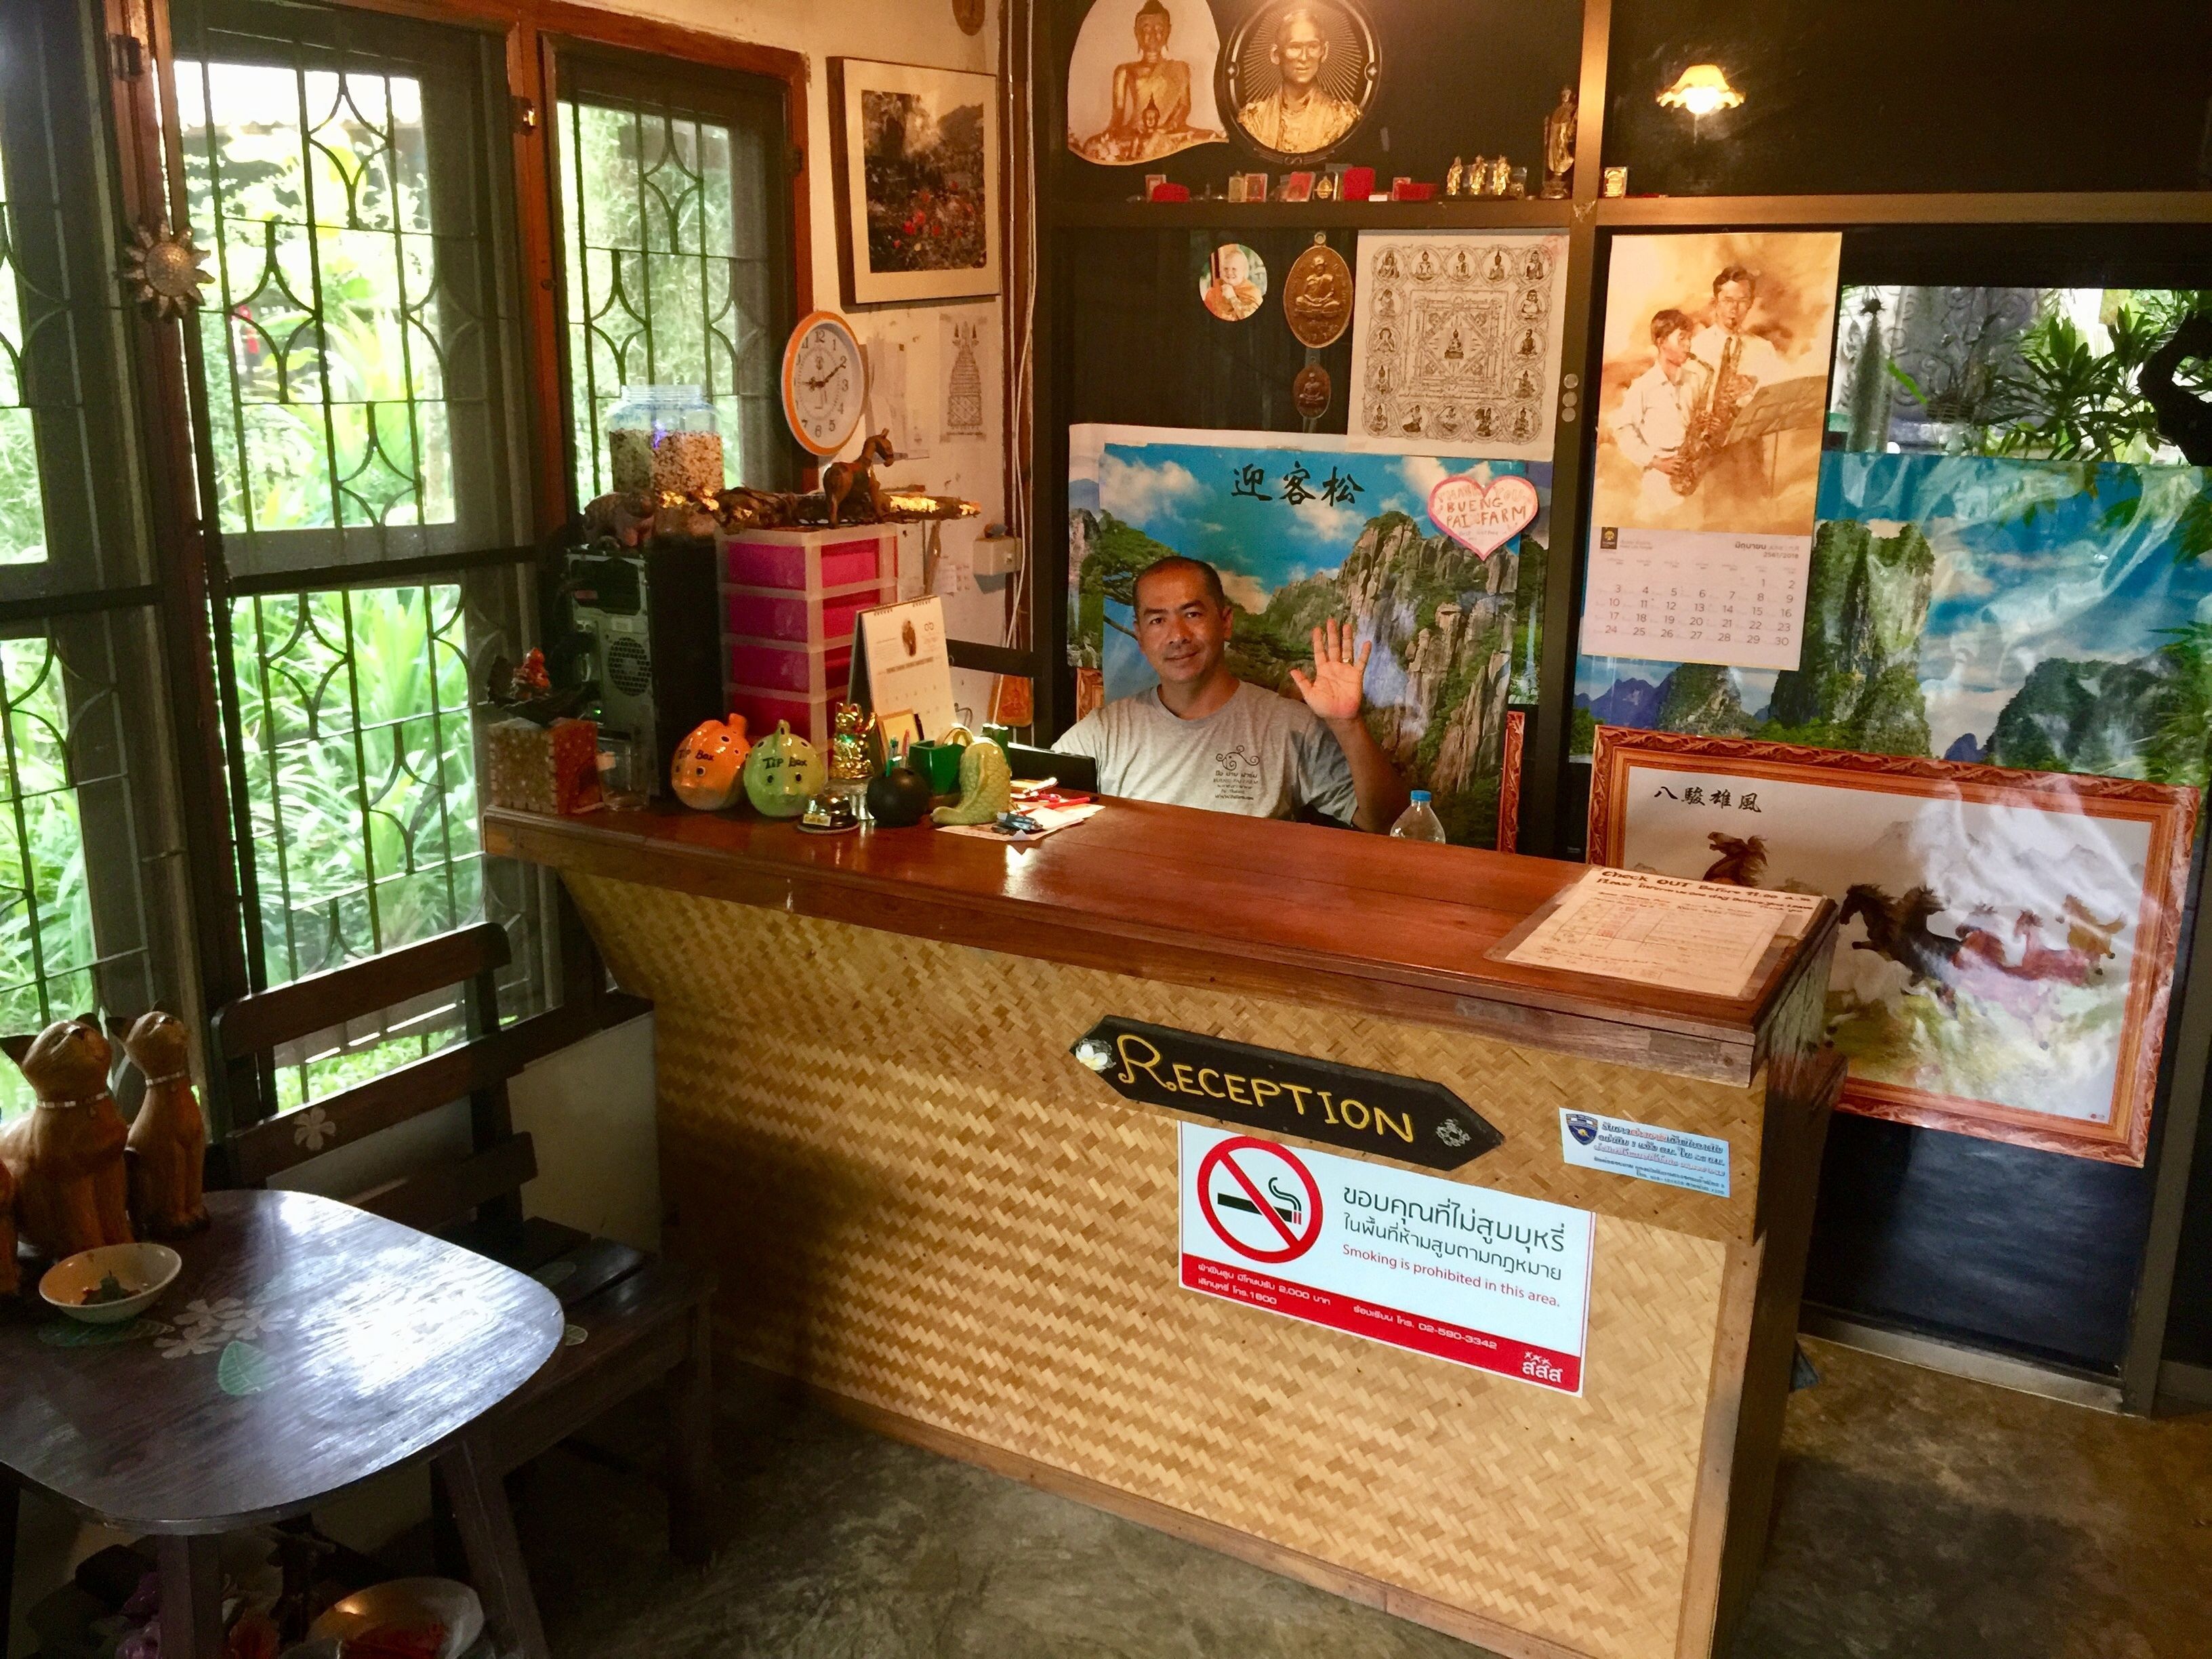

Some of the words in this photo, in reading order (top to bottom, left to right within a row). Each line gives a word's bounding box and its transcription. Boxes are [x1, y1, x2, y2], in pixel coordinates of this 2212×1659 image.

[815, 330, 825, 343] 12
[832, 339, 837, 351] 1
[840, 355, 848, 369] 2
[842, 379, 849, 392] 3
[838, 402, 844, 415] 4
[815, 425, 822, 438] 6
[829, 419, 836, 432] 5
[1231, 461, 1365, 507] 迎客松
[1447, 497, 1503, 513] BUENG
[1446, 514, 1471, 528] PAI
[1481, 506, 1526, 526] FARM
[1616, 584, 1621, 593] 3
[1671, 588, 1677, 596] 5
[1699, 590, 1706, 598] 6
[1729, 591, 1736, 599] 7
[1757, 593, 1764, 601] 8
[1786, 594, 1794, 603] 9
[1762, 579, 1765, 588] 1
[1788, 580, 1795, 589] 2
[1610, 598, 1620, 607] 10
[1641, 600, 1647, 608] 11
[1666, 602, 1676, 610] 12
[1694, 603, 1705, 612] 13
[1753, 607, 1763, 615] 15
[1781, 609, 1792, 617] 16
[1610, 612, 1619, 620] 17
[1637, 613, 1647, 622] 18
[1664, 615, 1675, 624] 19
[1689, 617, 1703, 626] 20
[1722, 619, 1732, 628] 21
[1749, 621, 1762, 630] 22
[1778, 623, 1790, 632] 23
[1605, 625, 1618, 634] 24
[1633, 627, 1645, 636] 25
[1660, 629, 1674, 638] 26
[1690, 631, 1702, 640] 27
[1717, 633, 1731, 642] 28
[1746, 635, 1760, 644] 29
[1775, 636, 1789, 646] 30
[695, 750, 714, 761] Box
[788, 756, 807, 767] Box
[1654, 786, 1761, 813] 八駿雄風
[1601, 871, 1649, 882] Check
[1657, 879, 1693, 887] OUT
[1115, 1033, 1414, 1143] RECEPTION
[1344, 1187, 1565, 1254] ขอบคุณที่ไม่สูบบุหรี่
[1343, 1212, 1561, 1280] ในพื้นที่ห้ามสูบตามกฎหมาย
[1343, 1244, 1397, 1269] Smoking
[1401, 1258, 1410, 1270] is
[1414, 1262, 1481, 1288] prohibited
[1485, 1277, 1496, 1291] in
[1500, 1282, 1524, 1298] this
[1528, 1291, 1560, 1307] area.
[1279, 1285, 1310, 1299] 2,000
[1313, 1294, 1331, 1306] บาท
[1418, 1323, 1498, 1349] 02-590-3342
